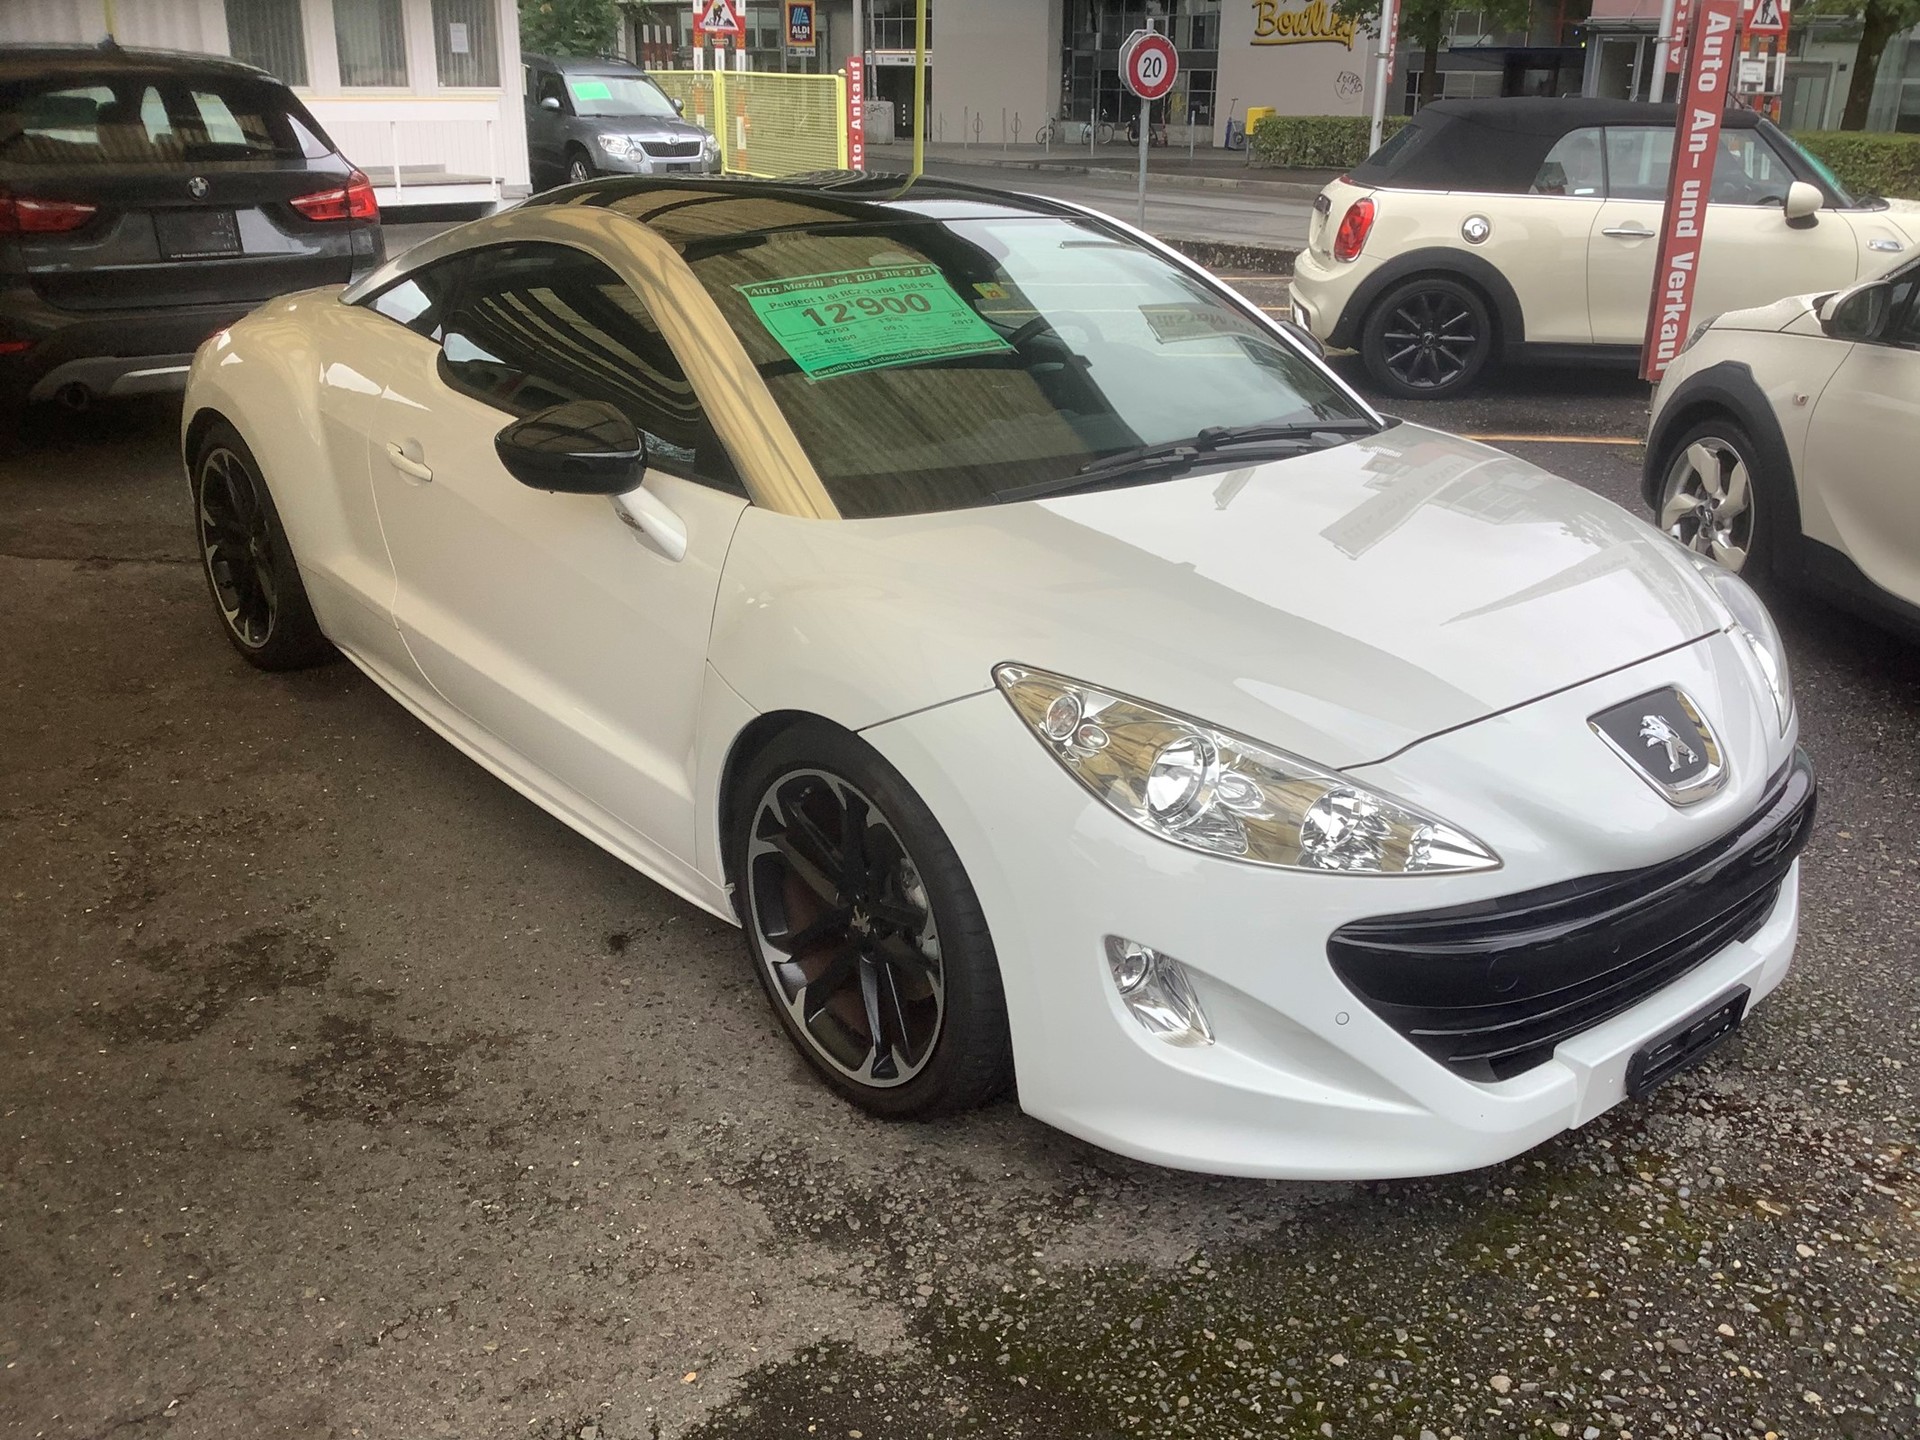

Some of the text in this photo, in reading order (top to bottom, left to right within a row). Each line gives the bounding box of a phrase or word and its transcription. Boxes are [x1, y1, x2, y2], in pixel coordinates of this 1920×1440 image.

[791, 25, 810, 34] ALDI
[1143, 57, 1162, 78] 20
[1698, 11, 1731, 92] Auto
[850, 61, 861, 130] Ankauf
[1688, 108, 1716, 168] An-
[1675, 180, 1701, 238] und
[750, 285, 779, 296] Auto
[783, 279, 824, 291] Marzili
[831, 276, 852, 285] Tel.
[856, 272, 877, 282] 031
[768, 296, 815, 309] Peugeot
[865, 286, 896, 295] Turbo
[801, 293, 932, 327] 12'900
